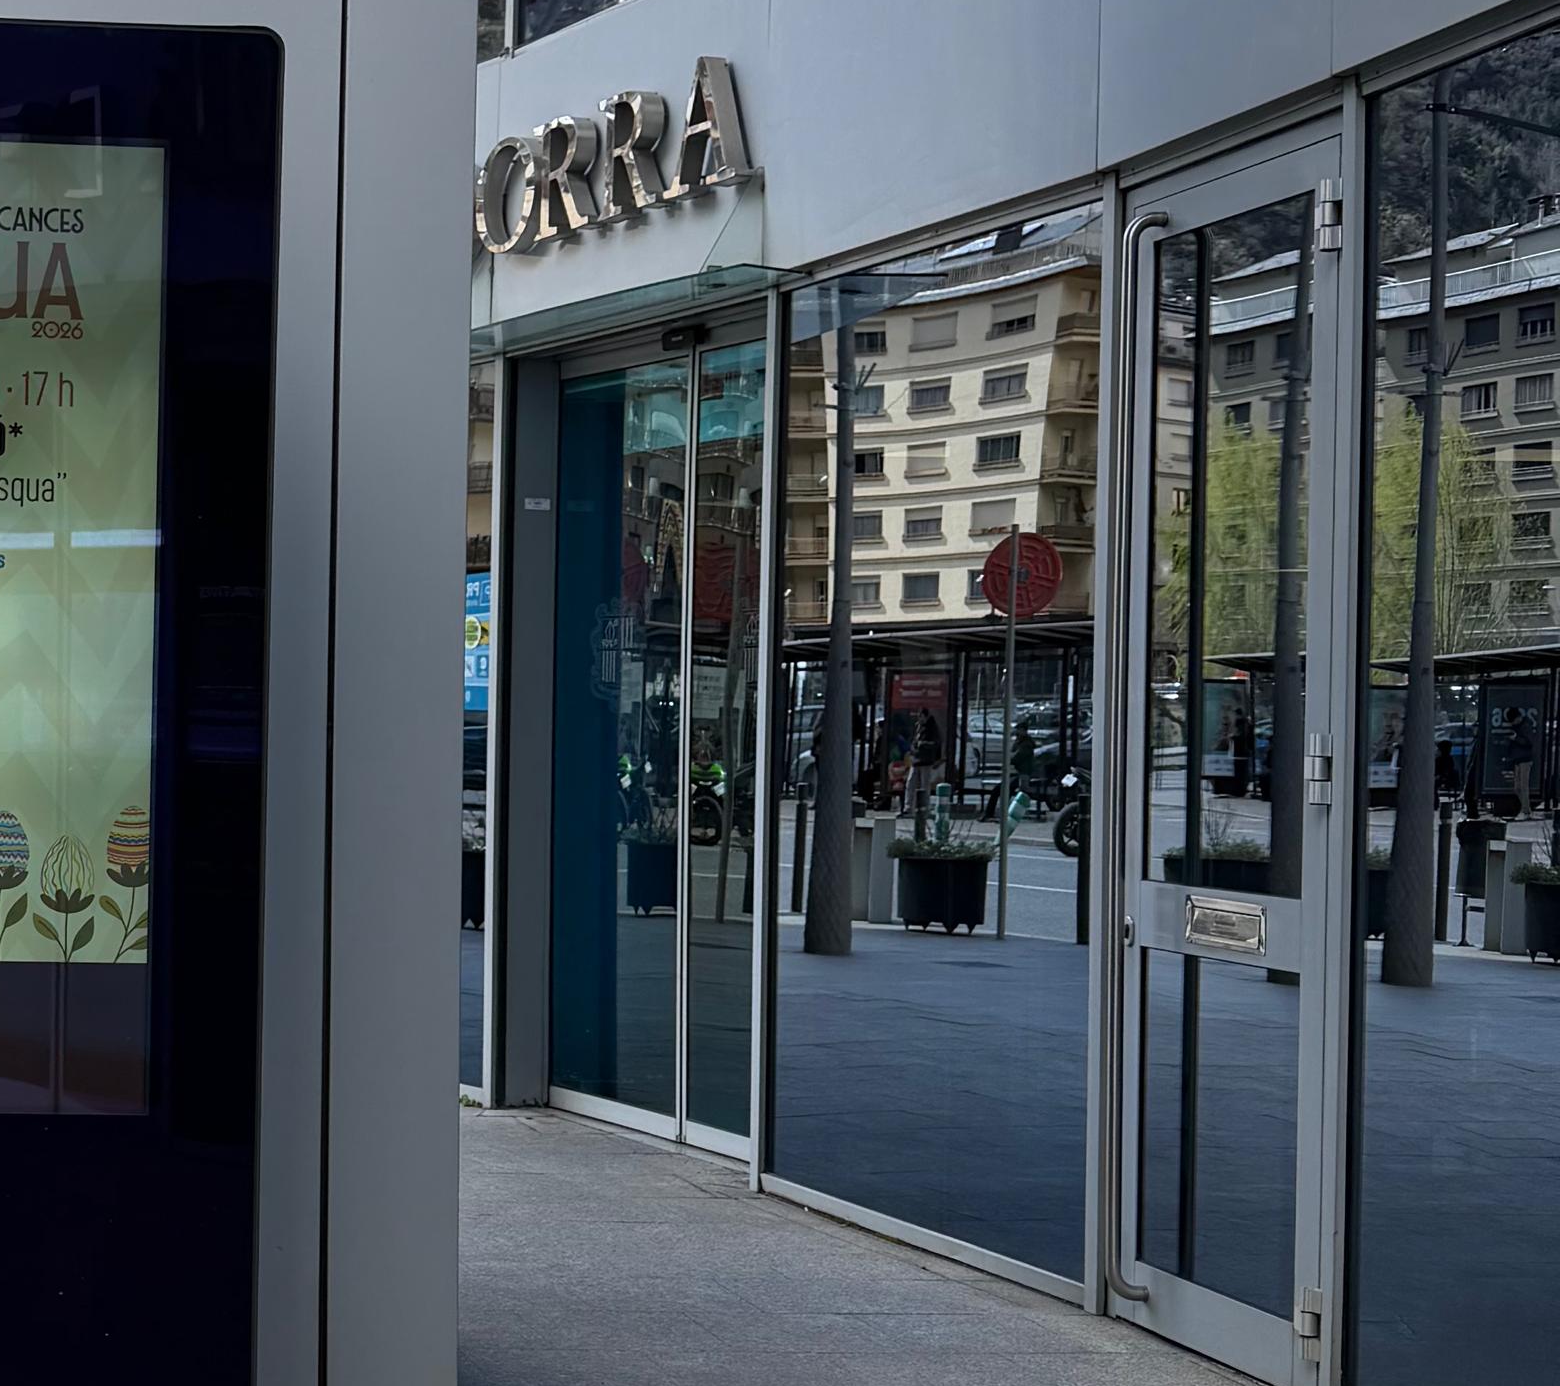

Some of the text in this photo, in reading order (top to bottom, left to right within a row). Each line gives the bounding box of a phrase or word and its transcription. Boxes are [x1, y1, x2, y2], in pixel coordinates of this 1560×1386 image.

[32, 321, 83, 340] 2026
[22, 371, 48, 406] 17
[59, 372, 73, 407] h
